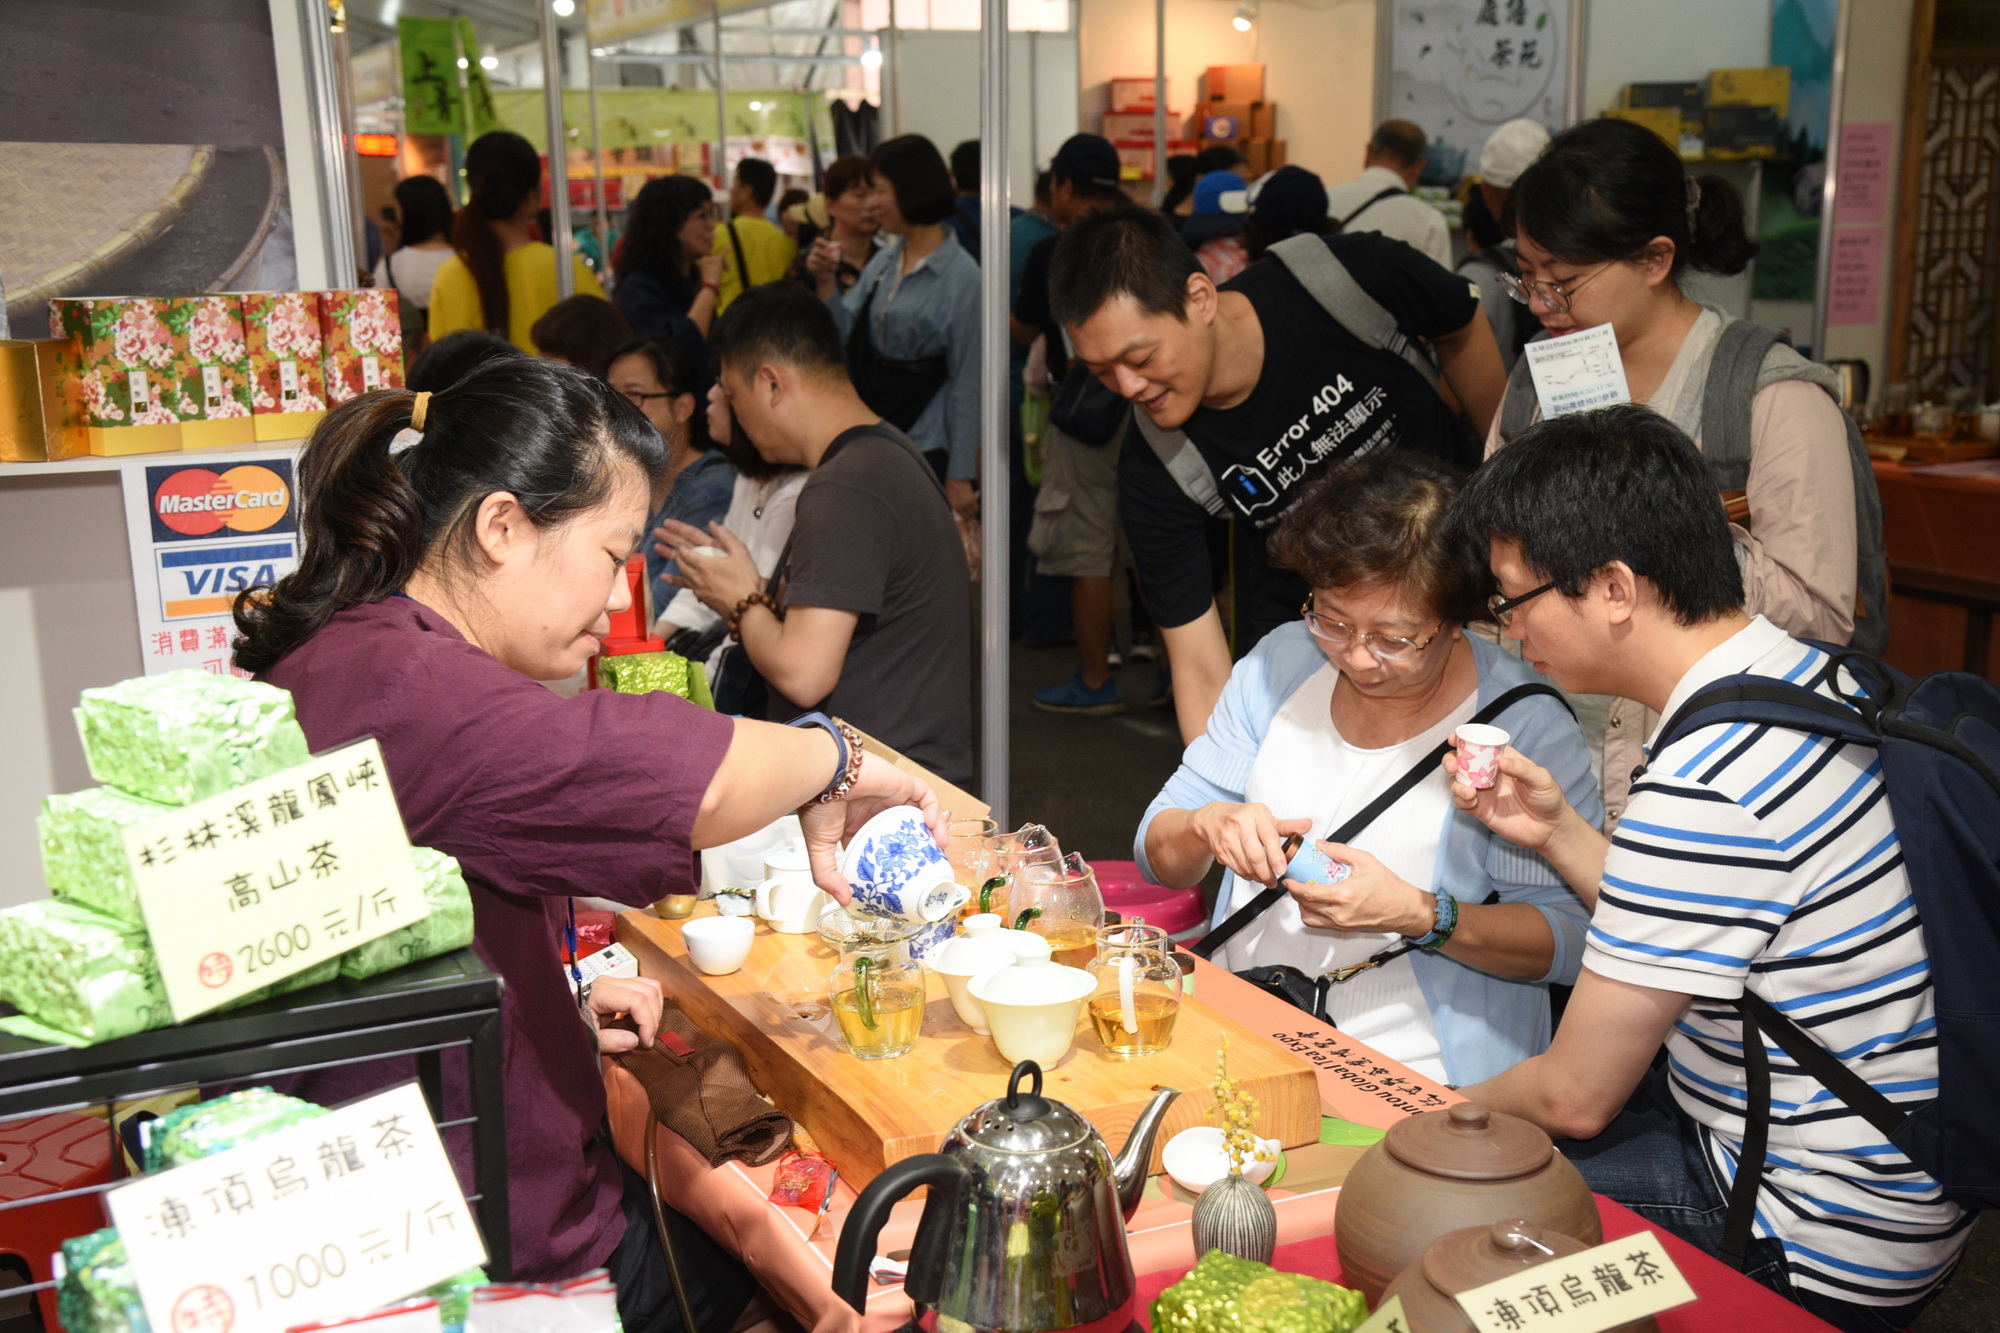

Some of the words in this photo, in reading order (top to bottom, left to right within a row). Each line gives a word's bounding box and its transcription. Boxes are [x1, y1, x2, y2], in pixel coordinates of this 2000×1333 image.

[1256, 414, 1311, 471] Error
[1312, 373, 1354, 416] 404
[1276, 386, 1387, 490] 此人無法顯示
[159, 487, 286, 514] MasterCard
[181, 563, 277, 596] VISA
[138, 757, 381, 867] 杉林溪龍鳳峽
[223, 840, 341, 912] 高山茶
[1272, 1032, 1310, 1053] Expo
[1305, 1051, 1334, 1067] Tea
[1323, 1063, 1380, 1092] Global
[143, 1113, 415, 1240] 凍頂烏龍茶
[1485, 1249, 1665, 1331] 凍頂烏龍茶
